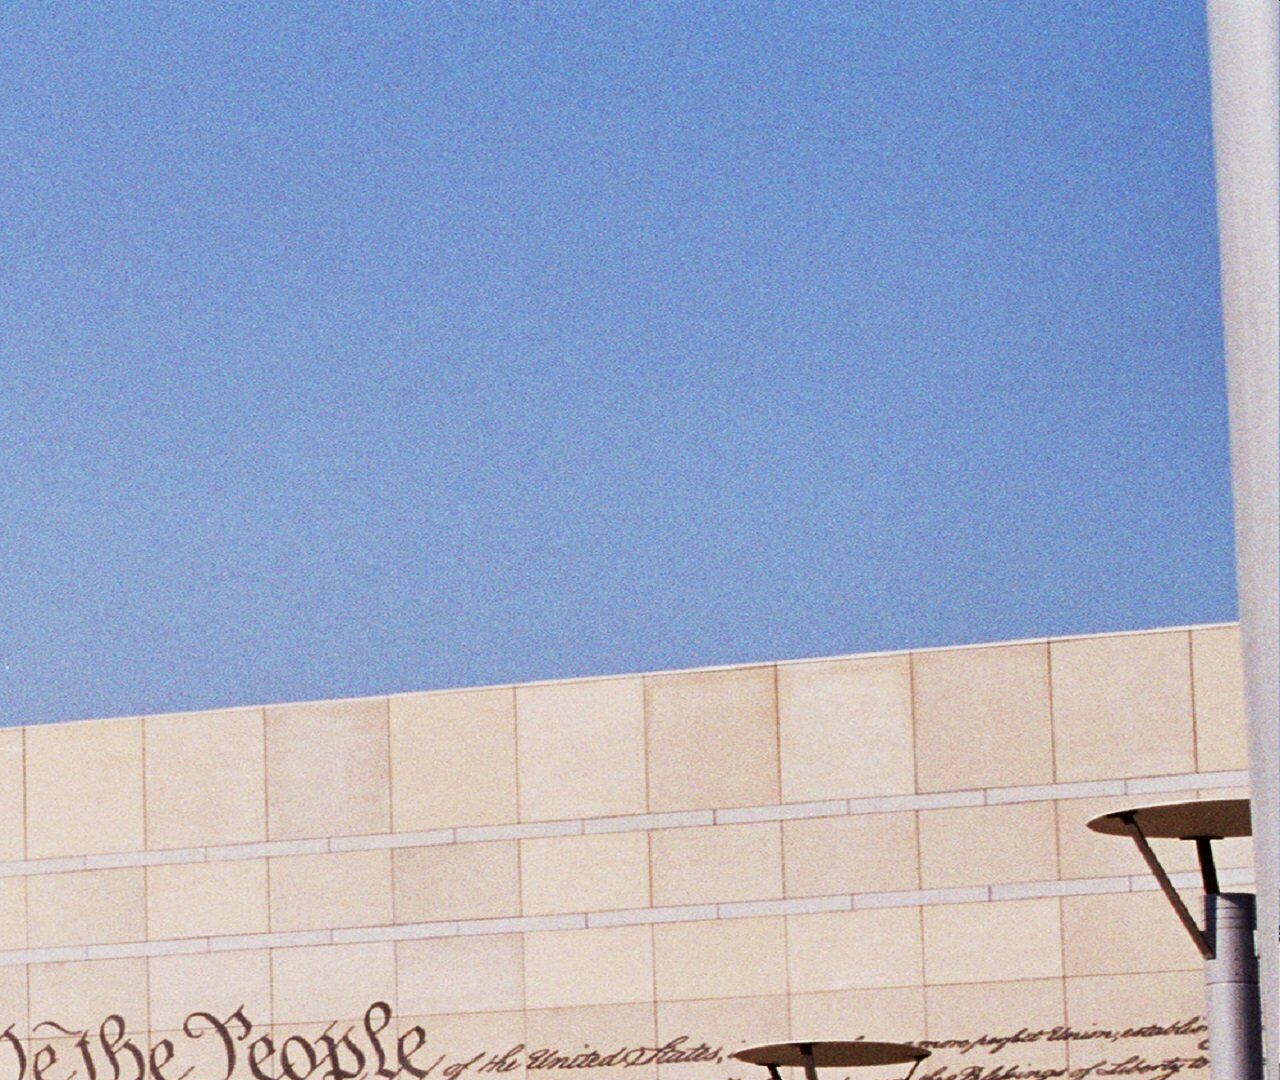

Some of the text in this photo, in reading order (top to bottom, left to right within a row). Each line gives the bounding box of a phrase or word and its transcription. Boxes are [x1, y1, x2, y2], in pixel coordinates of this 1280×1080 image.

[478, 1043, 525, 1073] the
[526, 1043, 627, 1069] United
[624, 1035, 723, 1068] States,
[960, 1027, 1046, 1054] perfect
